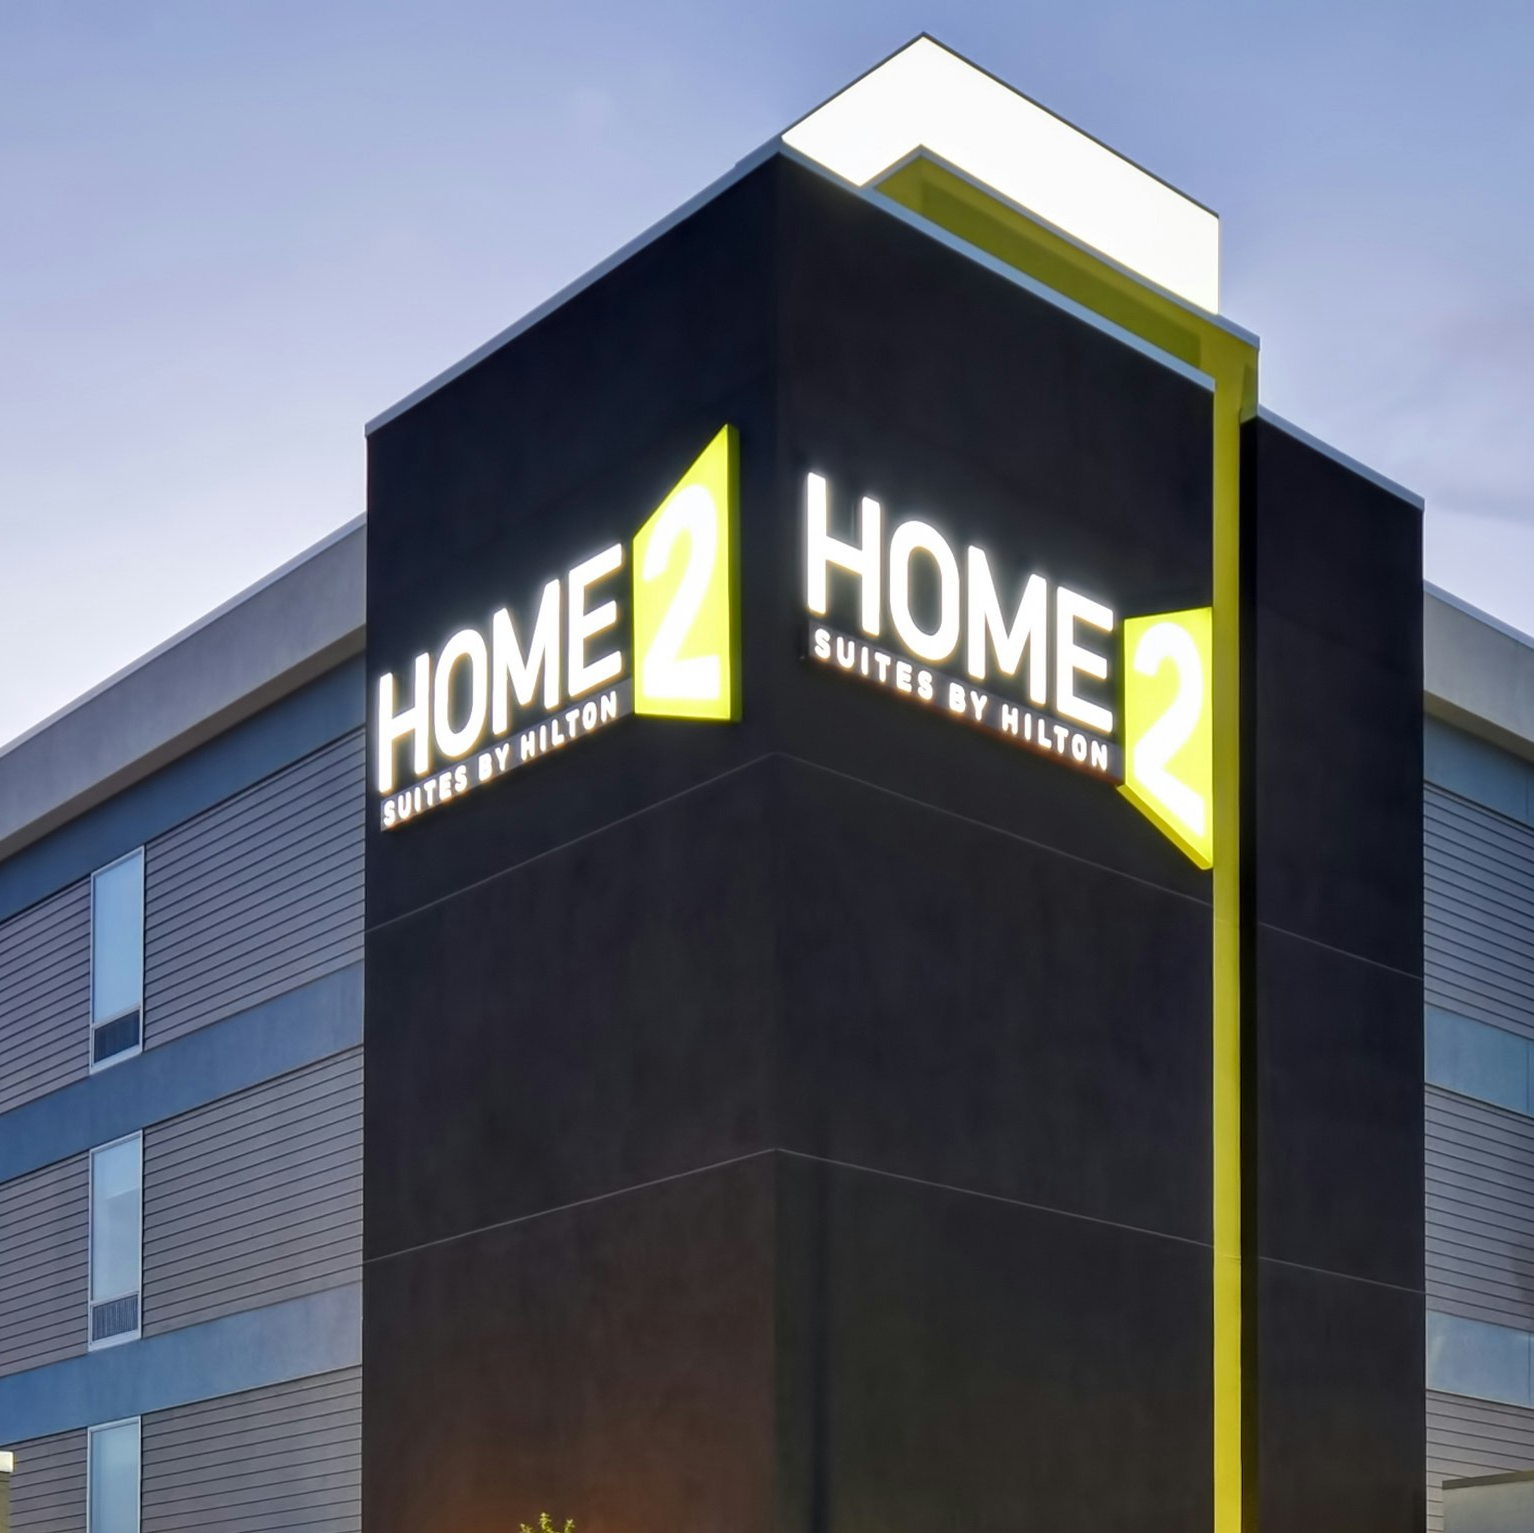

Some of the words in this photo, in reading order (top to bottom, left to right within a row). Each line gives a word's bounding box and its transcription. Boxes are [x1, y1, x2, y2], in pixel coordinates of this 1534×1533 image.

[378, 542, 623, 795] HOME
[641, 482, 718, 700] 2
[807, 471, 1115, 734] HOME
[1133, 621, 1205, 839] 2
[814, 628, 935, 702] SUITES
[949, 681, 988, 722] BY
[1001, 703, 1109, 772] HILTON
[382, 764, 469, 828] SUITES
[477, 742, 511, 783] BY
[519, 689, 619, 762] HILTON
